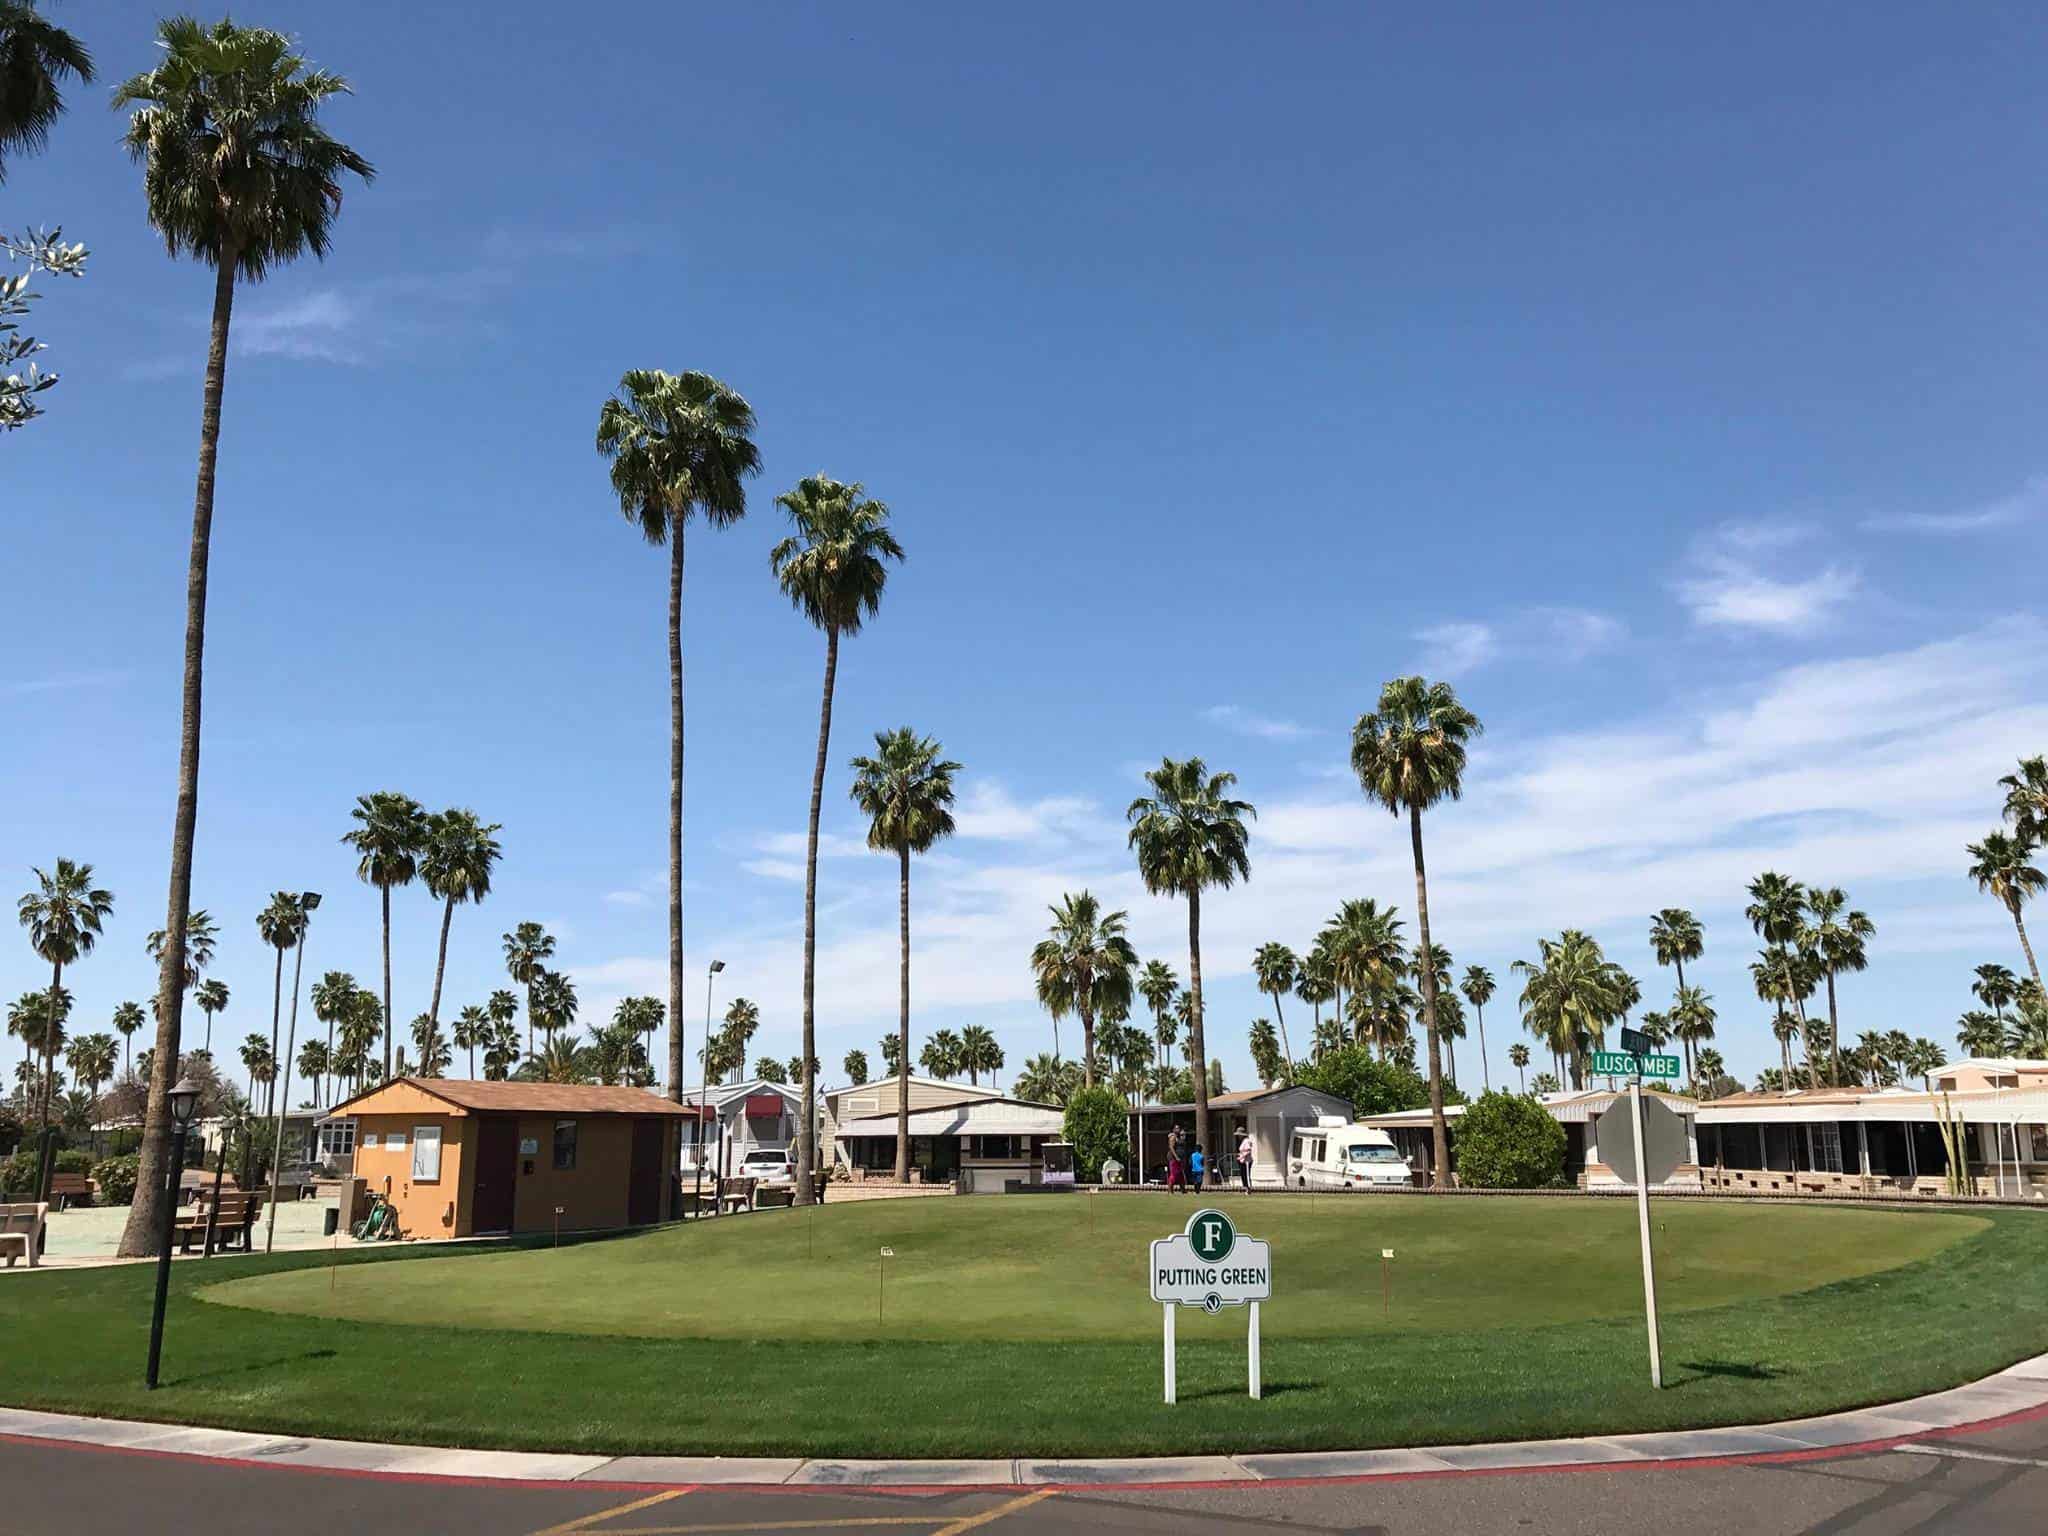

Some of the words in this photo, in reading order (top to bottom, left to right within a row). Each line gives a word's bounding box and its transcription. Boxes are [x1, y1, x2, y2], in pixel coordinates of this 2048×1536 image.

[1202, 1222, 1222, 1252] F
[1159, 1268, 1217, 1286] PUTTING
[1221, 1268, 1266, 1285] GREEN
